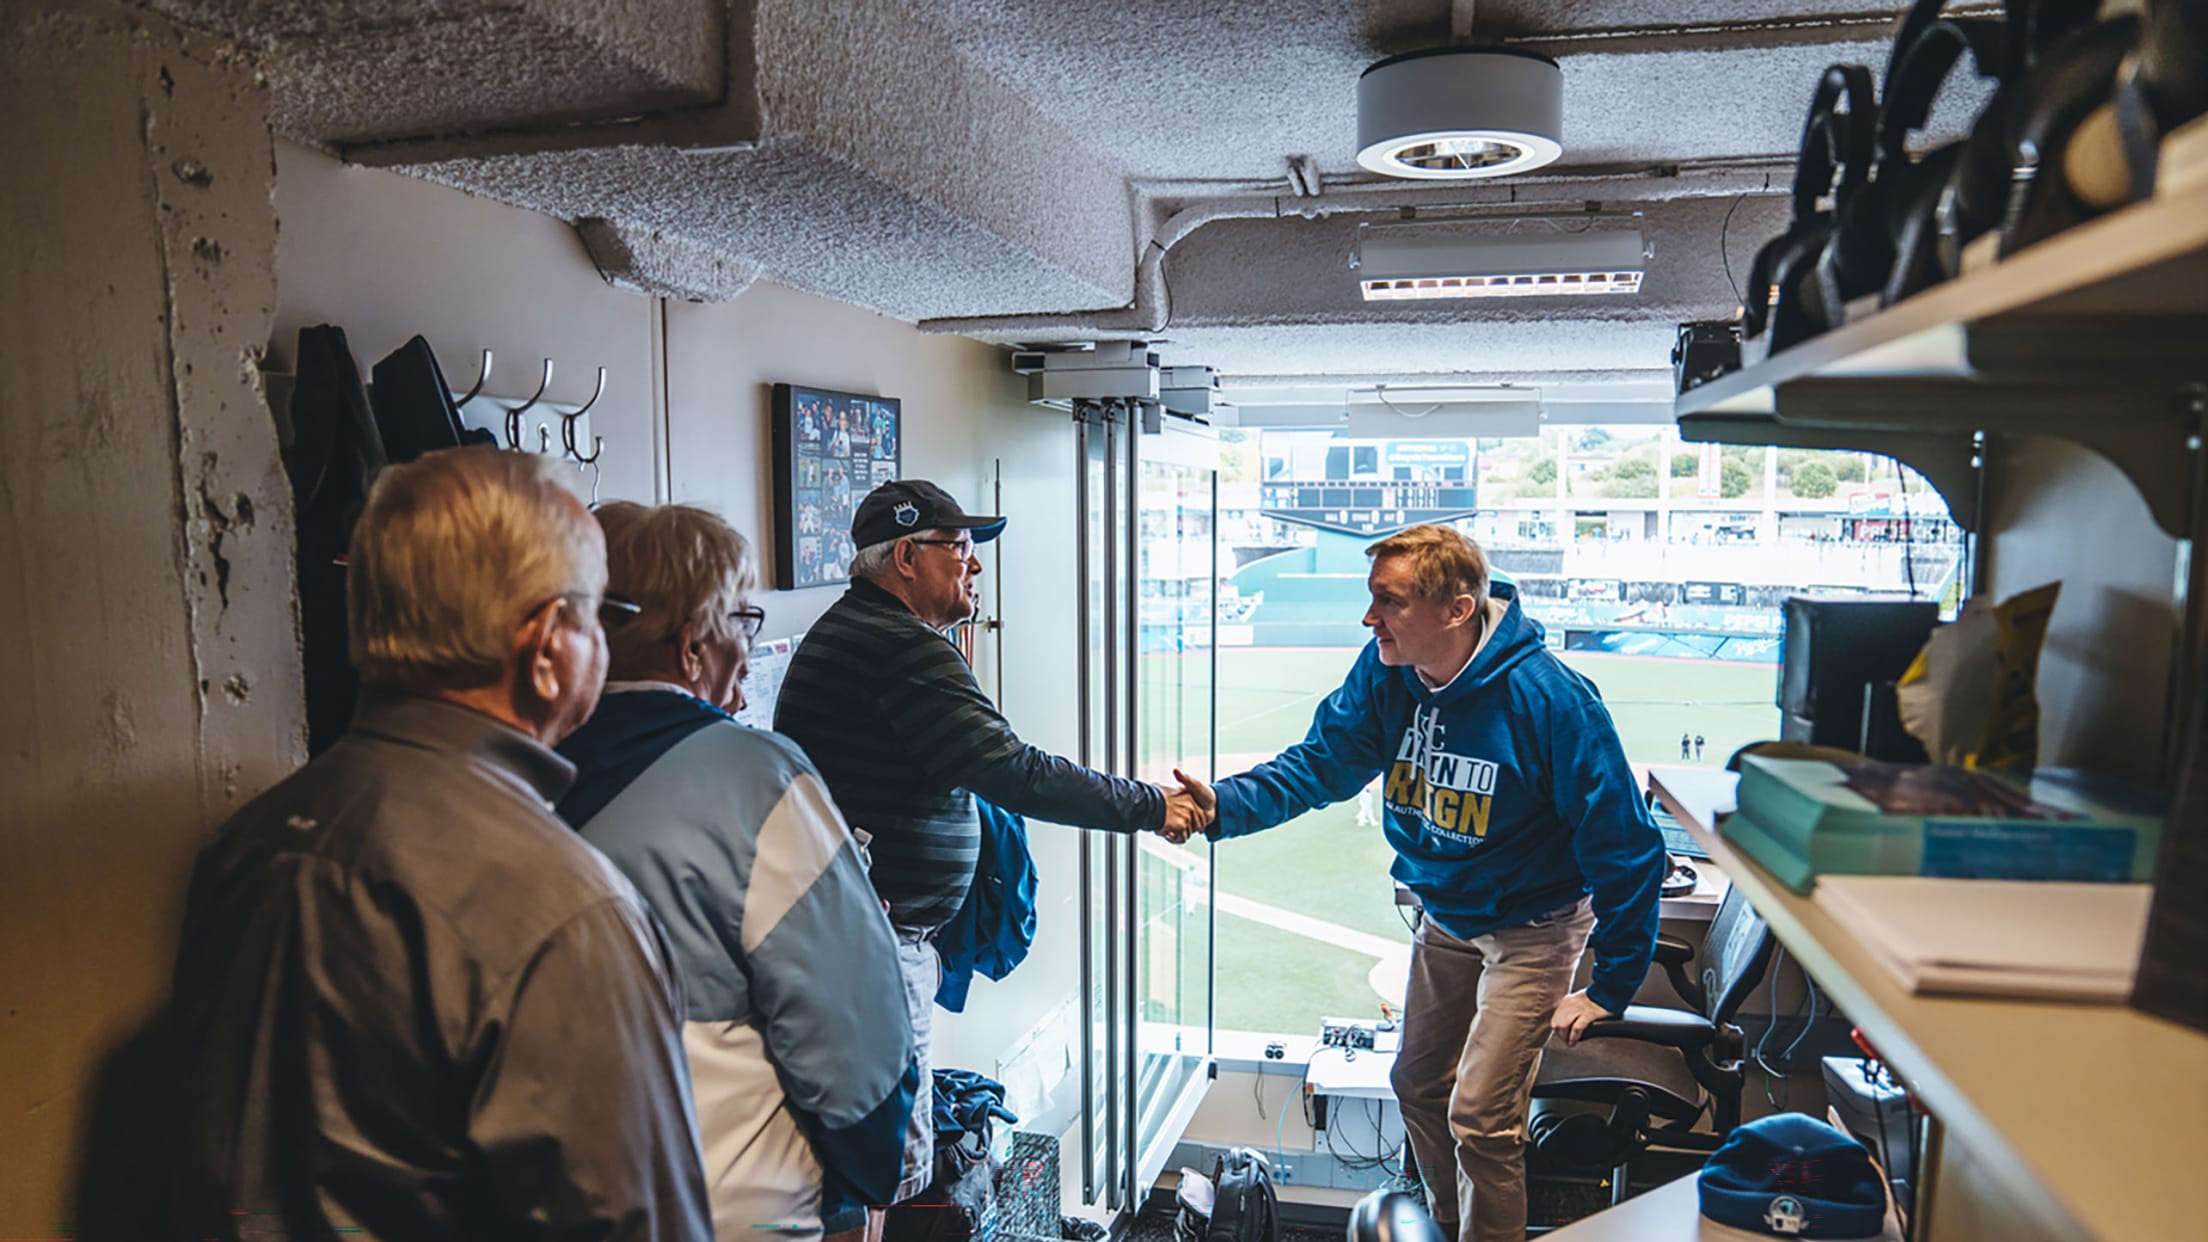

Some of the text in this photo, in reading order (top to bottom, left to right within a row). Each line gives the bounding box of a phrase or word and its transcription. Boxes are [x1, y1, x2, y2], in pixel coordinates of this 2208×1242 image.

[1466, 761, 1494, 791] TO
[1385, 762, 1492, 836] REIGN
[1393, 804, 1431, 831] AUTHIC
